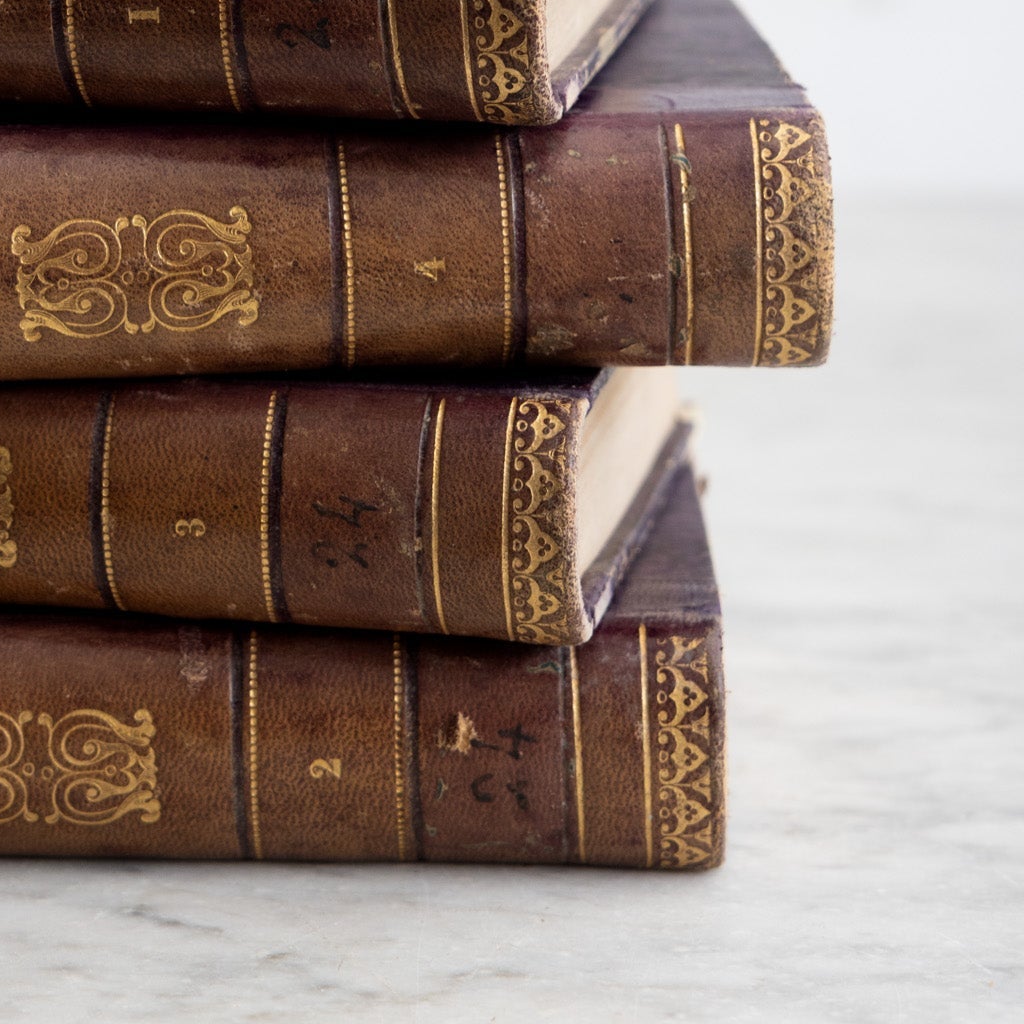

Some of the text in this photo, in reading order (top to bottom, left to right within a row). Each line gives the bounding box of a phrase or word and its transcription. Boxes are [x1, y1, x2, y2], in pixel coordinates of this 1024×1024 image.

[414, 256, 445, 282] 4
[175, 516, 206, 538] 3
[309, 758, 342, 780] 2
